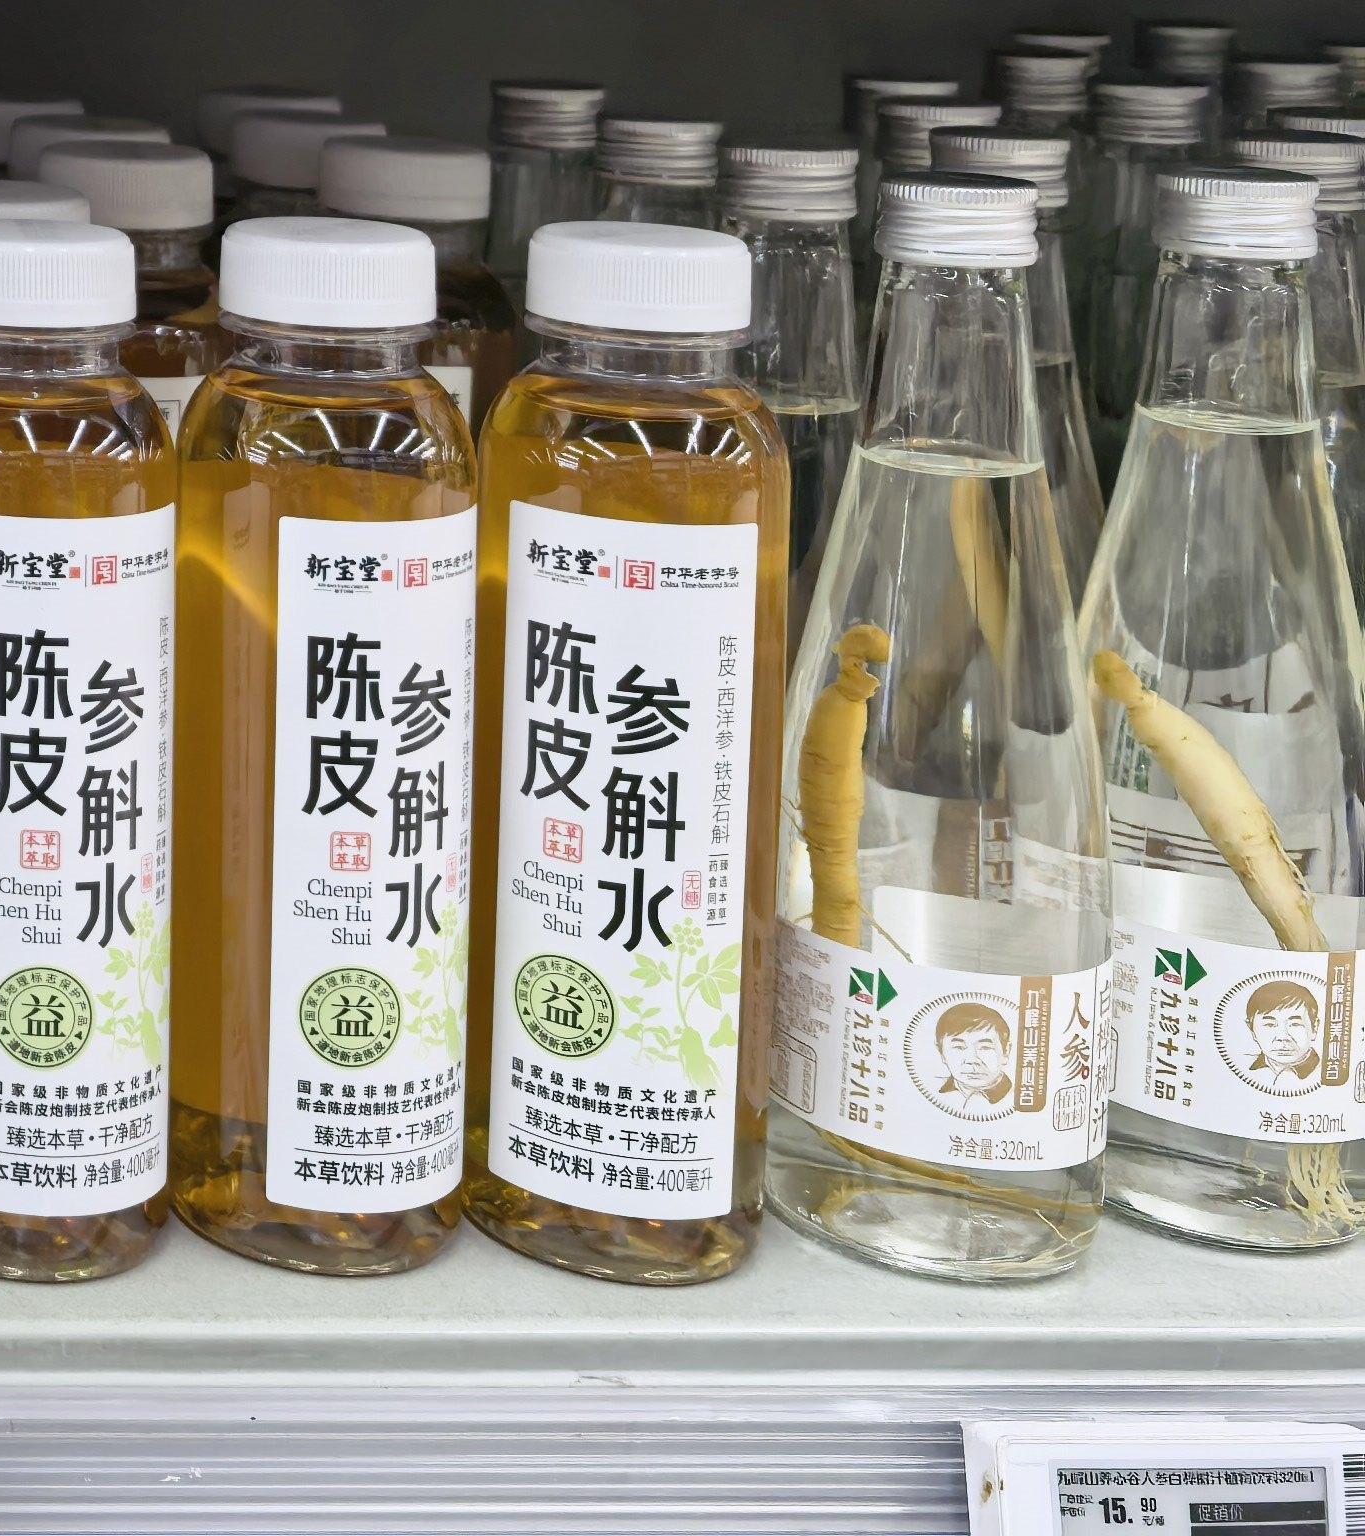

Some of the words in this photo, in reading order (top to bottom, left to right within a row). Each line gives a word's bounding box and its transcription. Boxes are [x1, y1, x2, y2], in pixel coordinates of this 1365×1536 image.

[526, 538, 598, 576] 新宝堂
[660, 567, 740, 580] 中华老字号
[293, 1156, 385, 1190] 本草饮料
